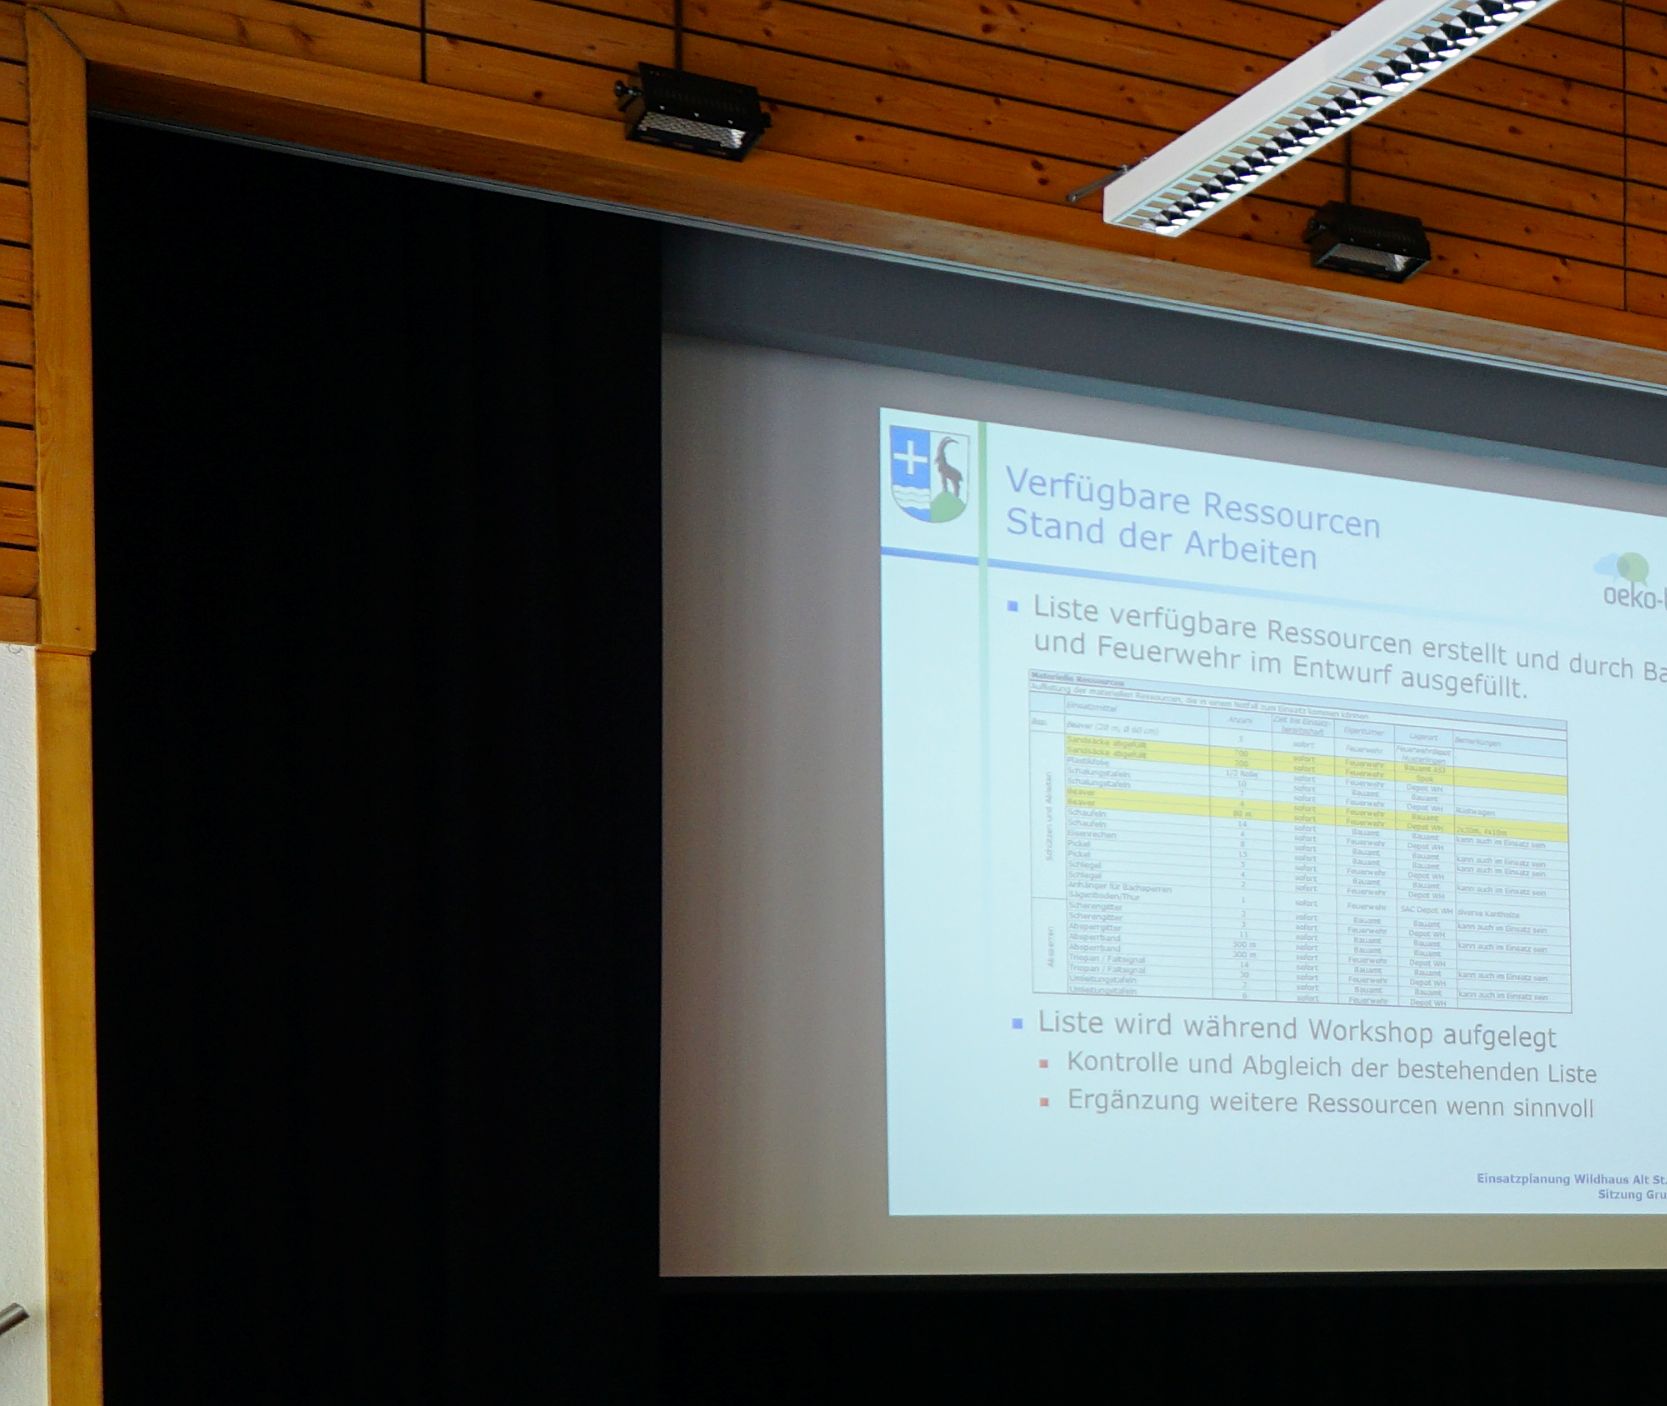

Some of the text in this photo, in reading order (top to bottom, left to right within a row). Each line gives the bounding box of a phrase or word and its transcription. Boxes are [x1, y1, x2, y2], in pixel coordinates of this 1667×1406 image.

[1006, 465, 1380, 538] Verfügbare Ressourcen
[1006, 507, 1317, 570] Stand der Arbeiten
[1035, 594, 1100, 623] Liste
[1110, 606, 1257, 640] verfügbare
[1268, 620, 1412, 656] Ressourcen
[1423, 641, 1509, 667] erstellt
[1517, 650, 1560, 672] und
[1569, 653, 1634, 680] durch
[1035, 632, 1528, 699] und Feuerwehr im Entwurf ausgefüllt.
[1040, 1009, 1558, 1053] Liste wird während Workshop aufgelegt
[1067, 1050, 1598, 1085] Kontrolle und Abgleich der bestehenden Liste
[1068, 1087, 1594, 1119] Ergänzung weitere Ressourcen wenn sinnvoll
[1477, 1173, 1571, 1186] Einsatzplanung
[1574, 1173, 1629, 1185] Wildhaus
[1633, 1174, 1650, 1185] Alt
[1598, 1189, 1643, 1202] Sitzung
